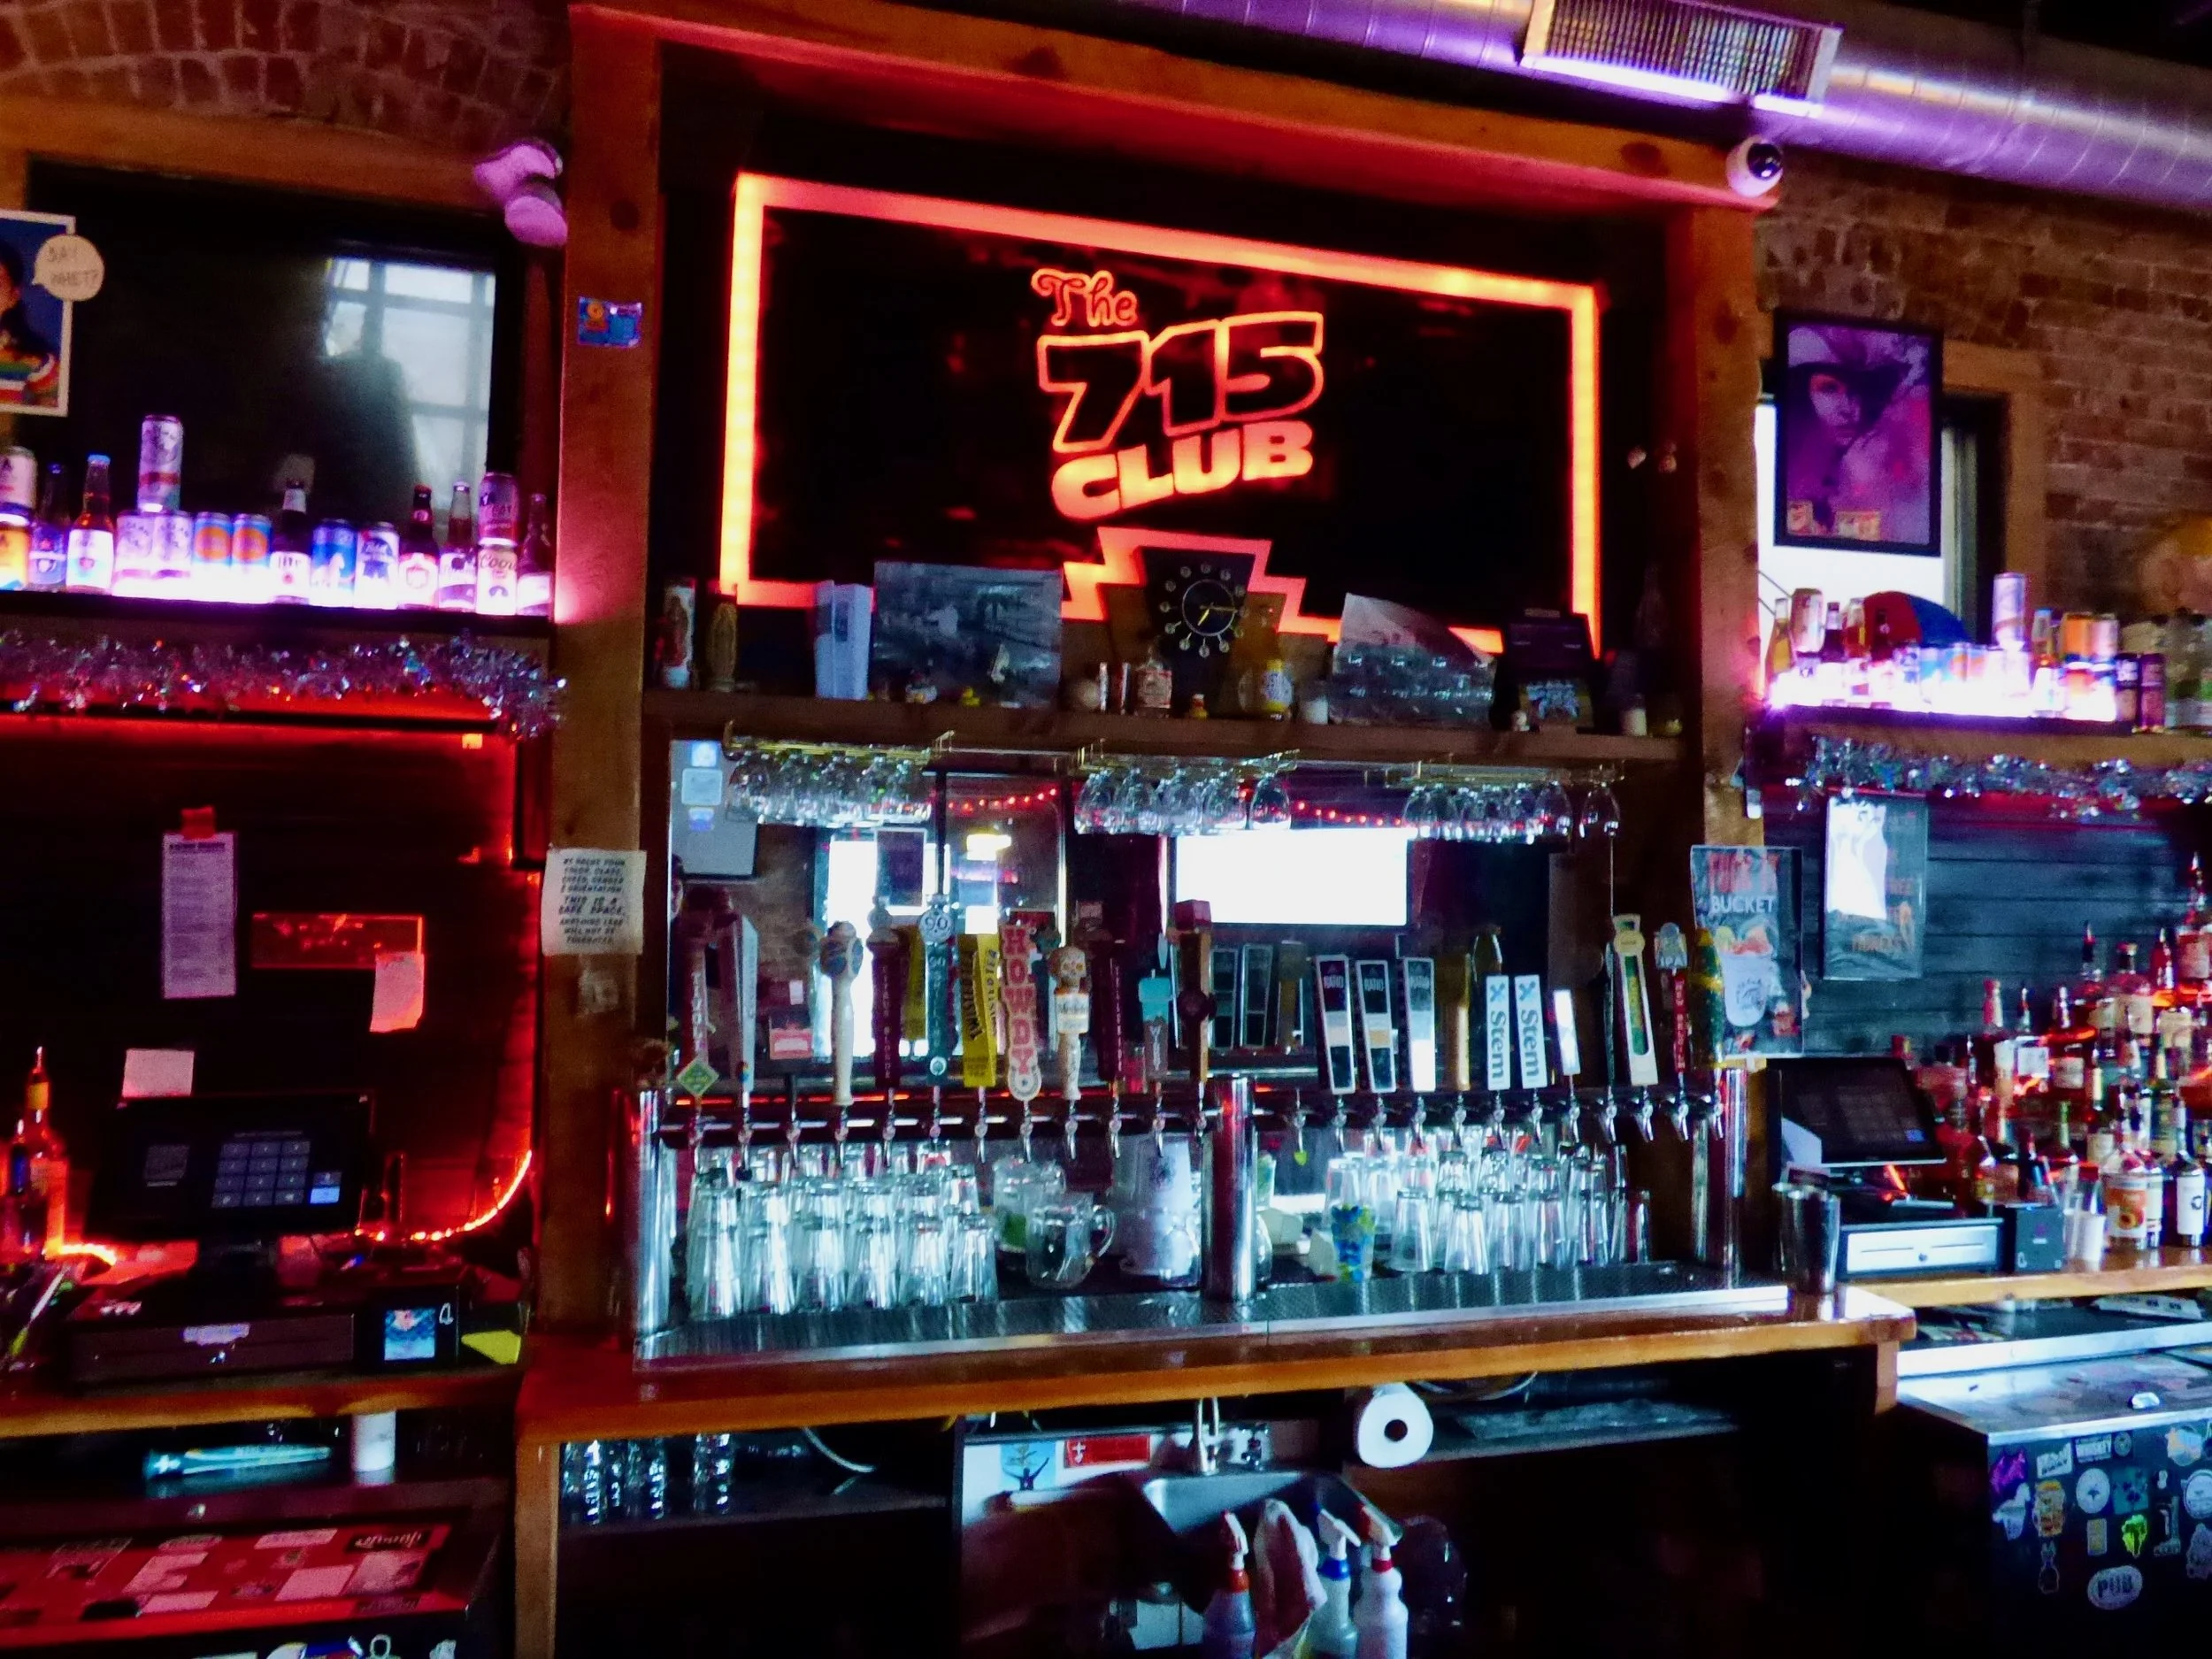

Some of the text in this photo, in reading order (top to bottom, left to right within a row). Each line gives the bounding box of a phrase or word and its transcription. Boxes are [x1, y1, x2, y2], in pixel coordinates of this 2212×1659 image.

[1032, 268, 1138, 326] The
[1037, 311, 1325, 453] 715
[1051, 419, 1314, 520] CLUB
[1710, 895, 1777, 914] BUCKET
[1002, 926, 1038, 1075] HOWDY
[1491, 1010, 1504, 1079] Stem
[1520, 1010, 1540, 1077] Stem
[2097, 1574, 2134, 1598] PUB
